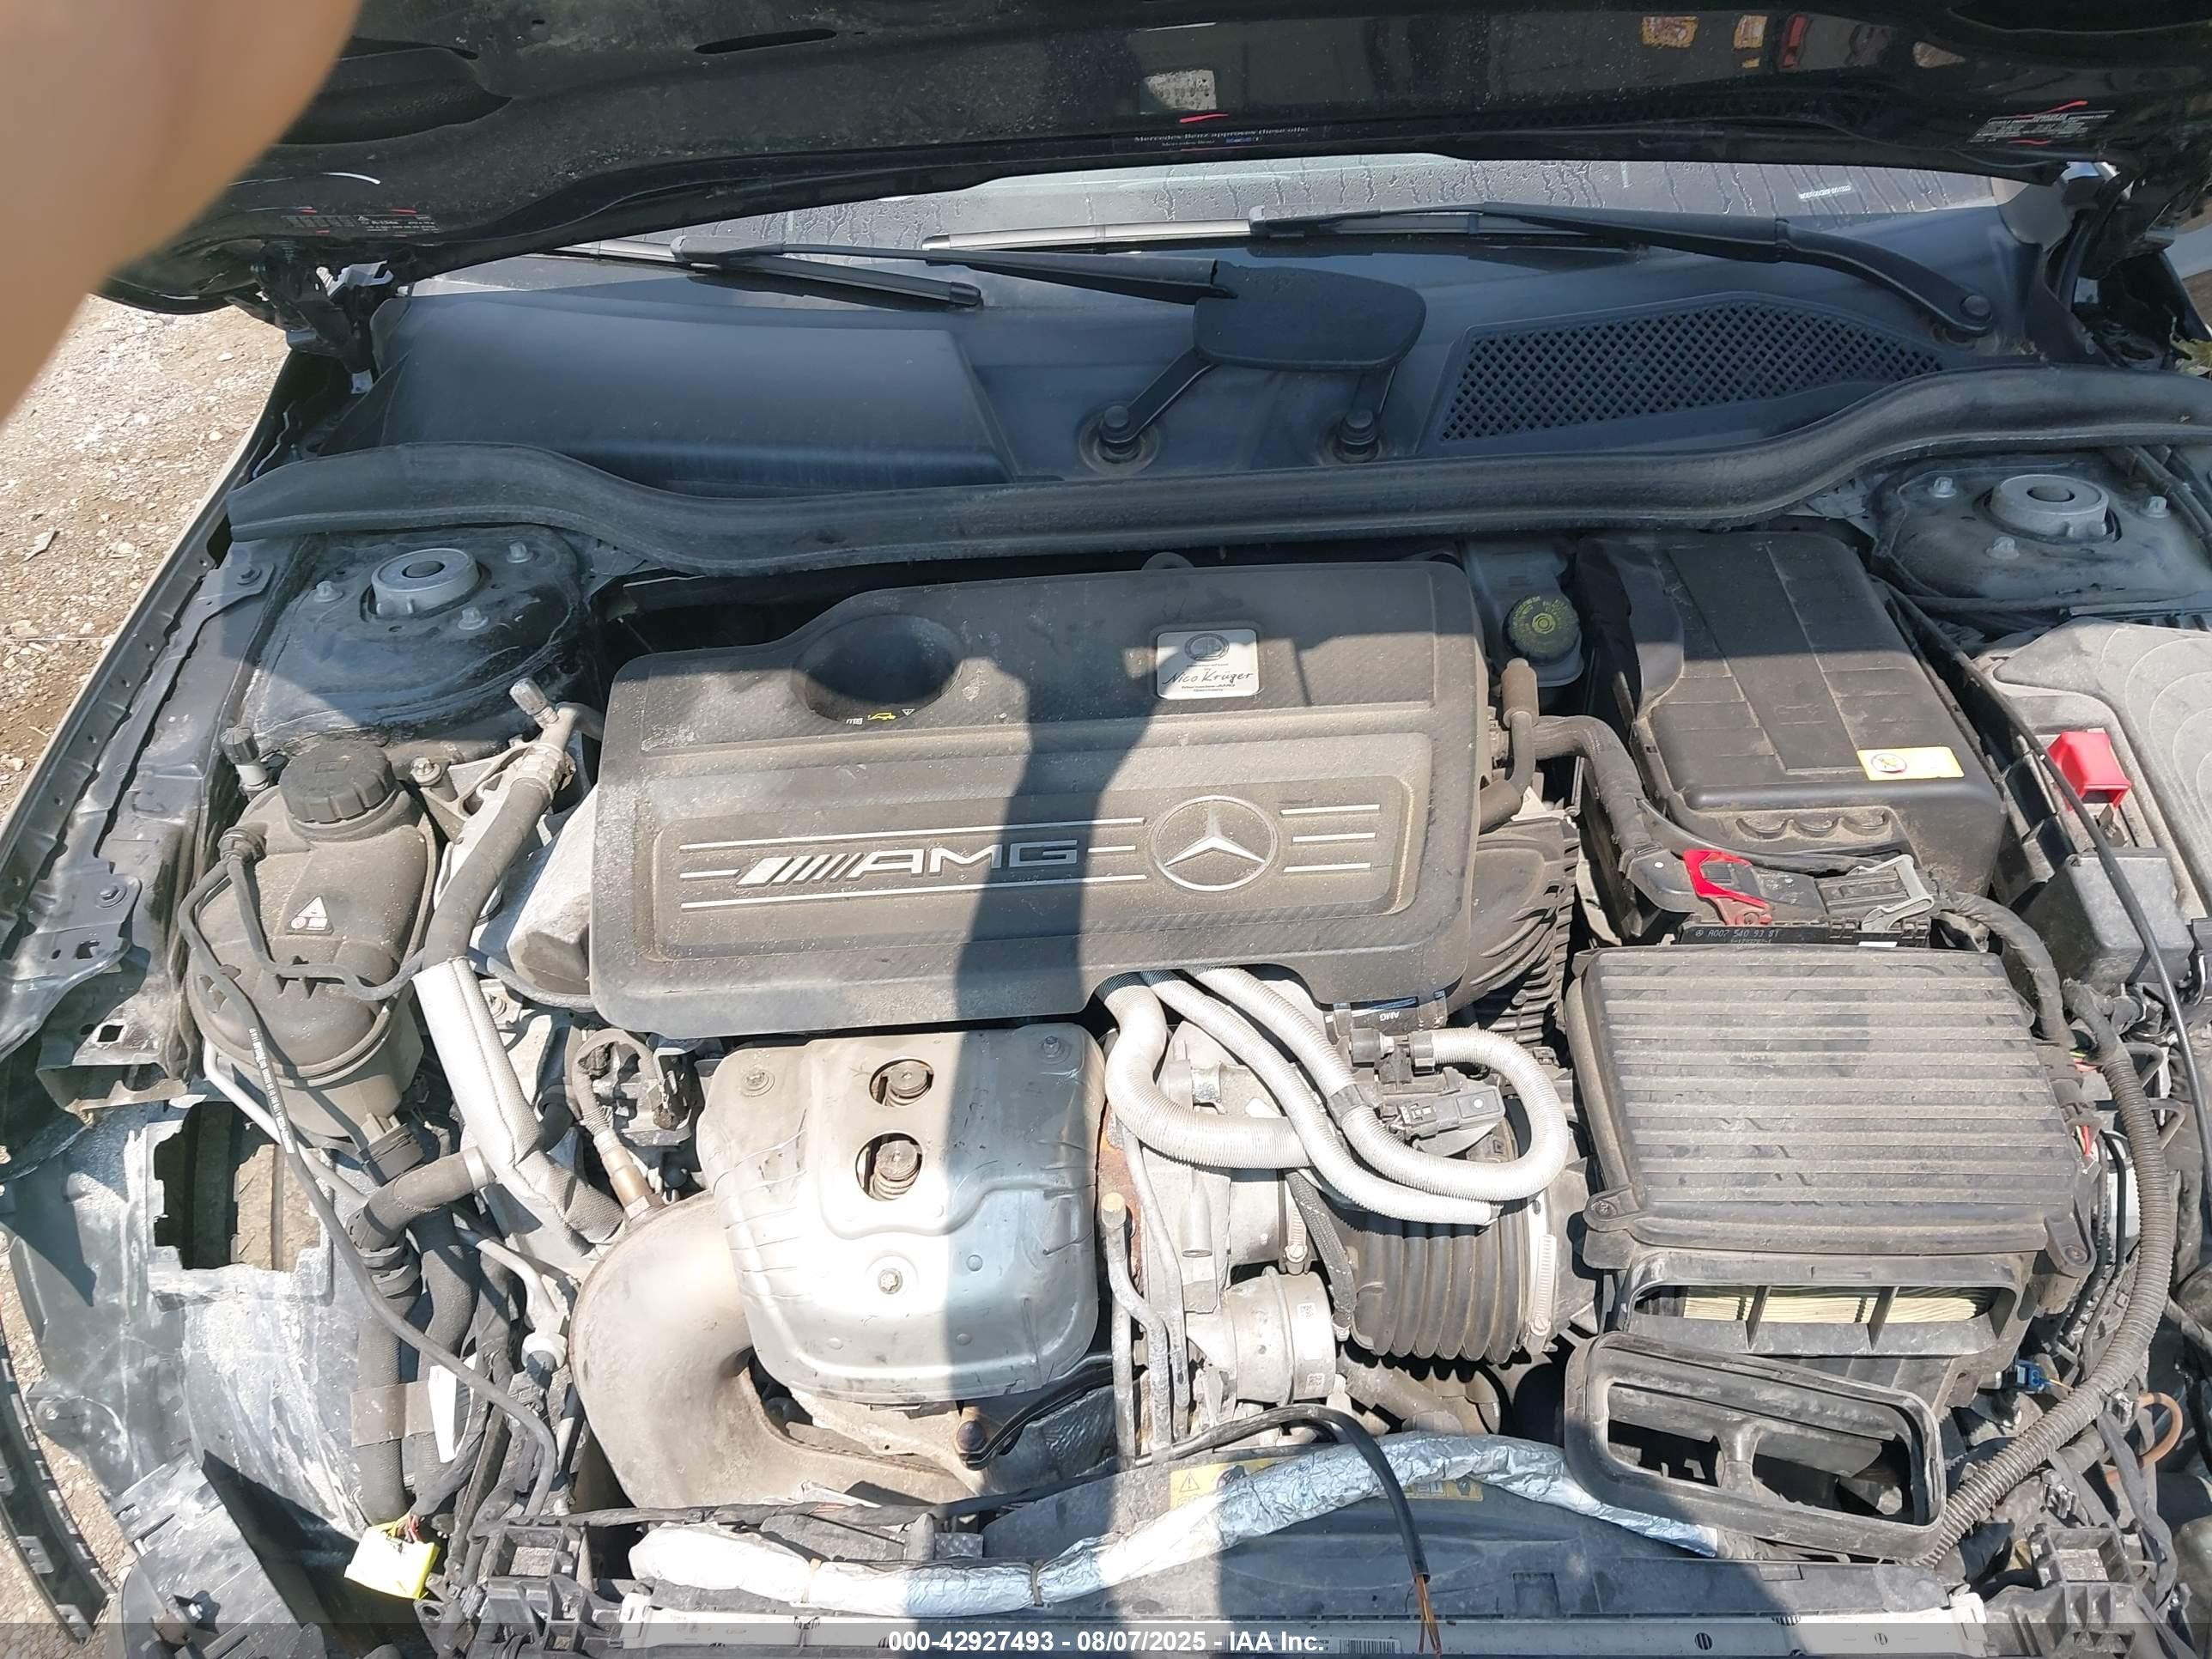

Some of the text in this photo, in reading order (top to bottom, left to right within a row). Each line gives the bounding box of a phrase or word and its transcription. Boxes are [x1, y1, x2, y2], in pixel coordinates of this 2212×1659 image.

[1161, 669, 1254, 684] Nico Krüger
[1379, 1011, 1401, 1022] AMG
